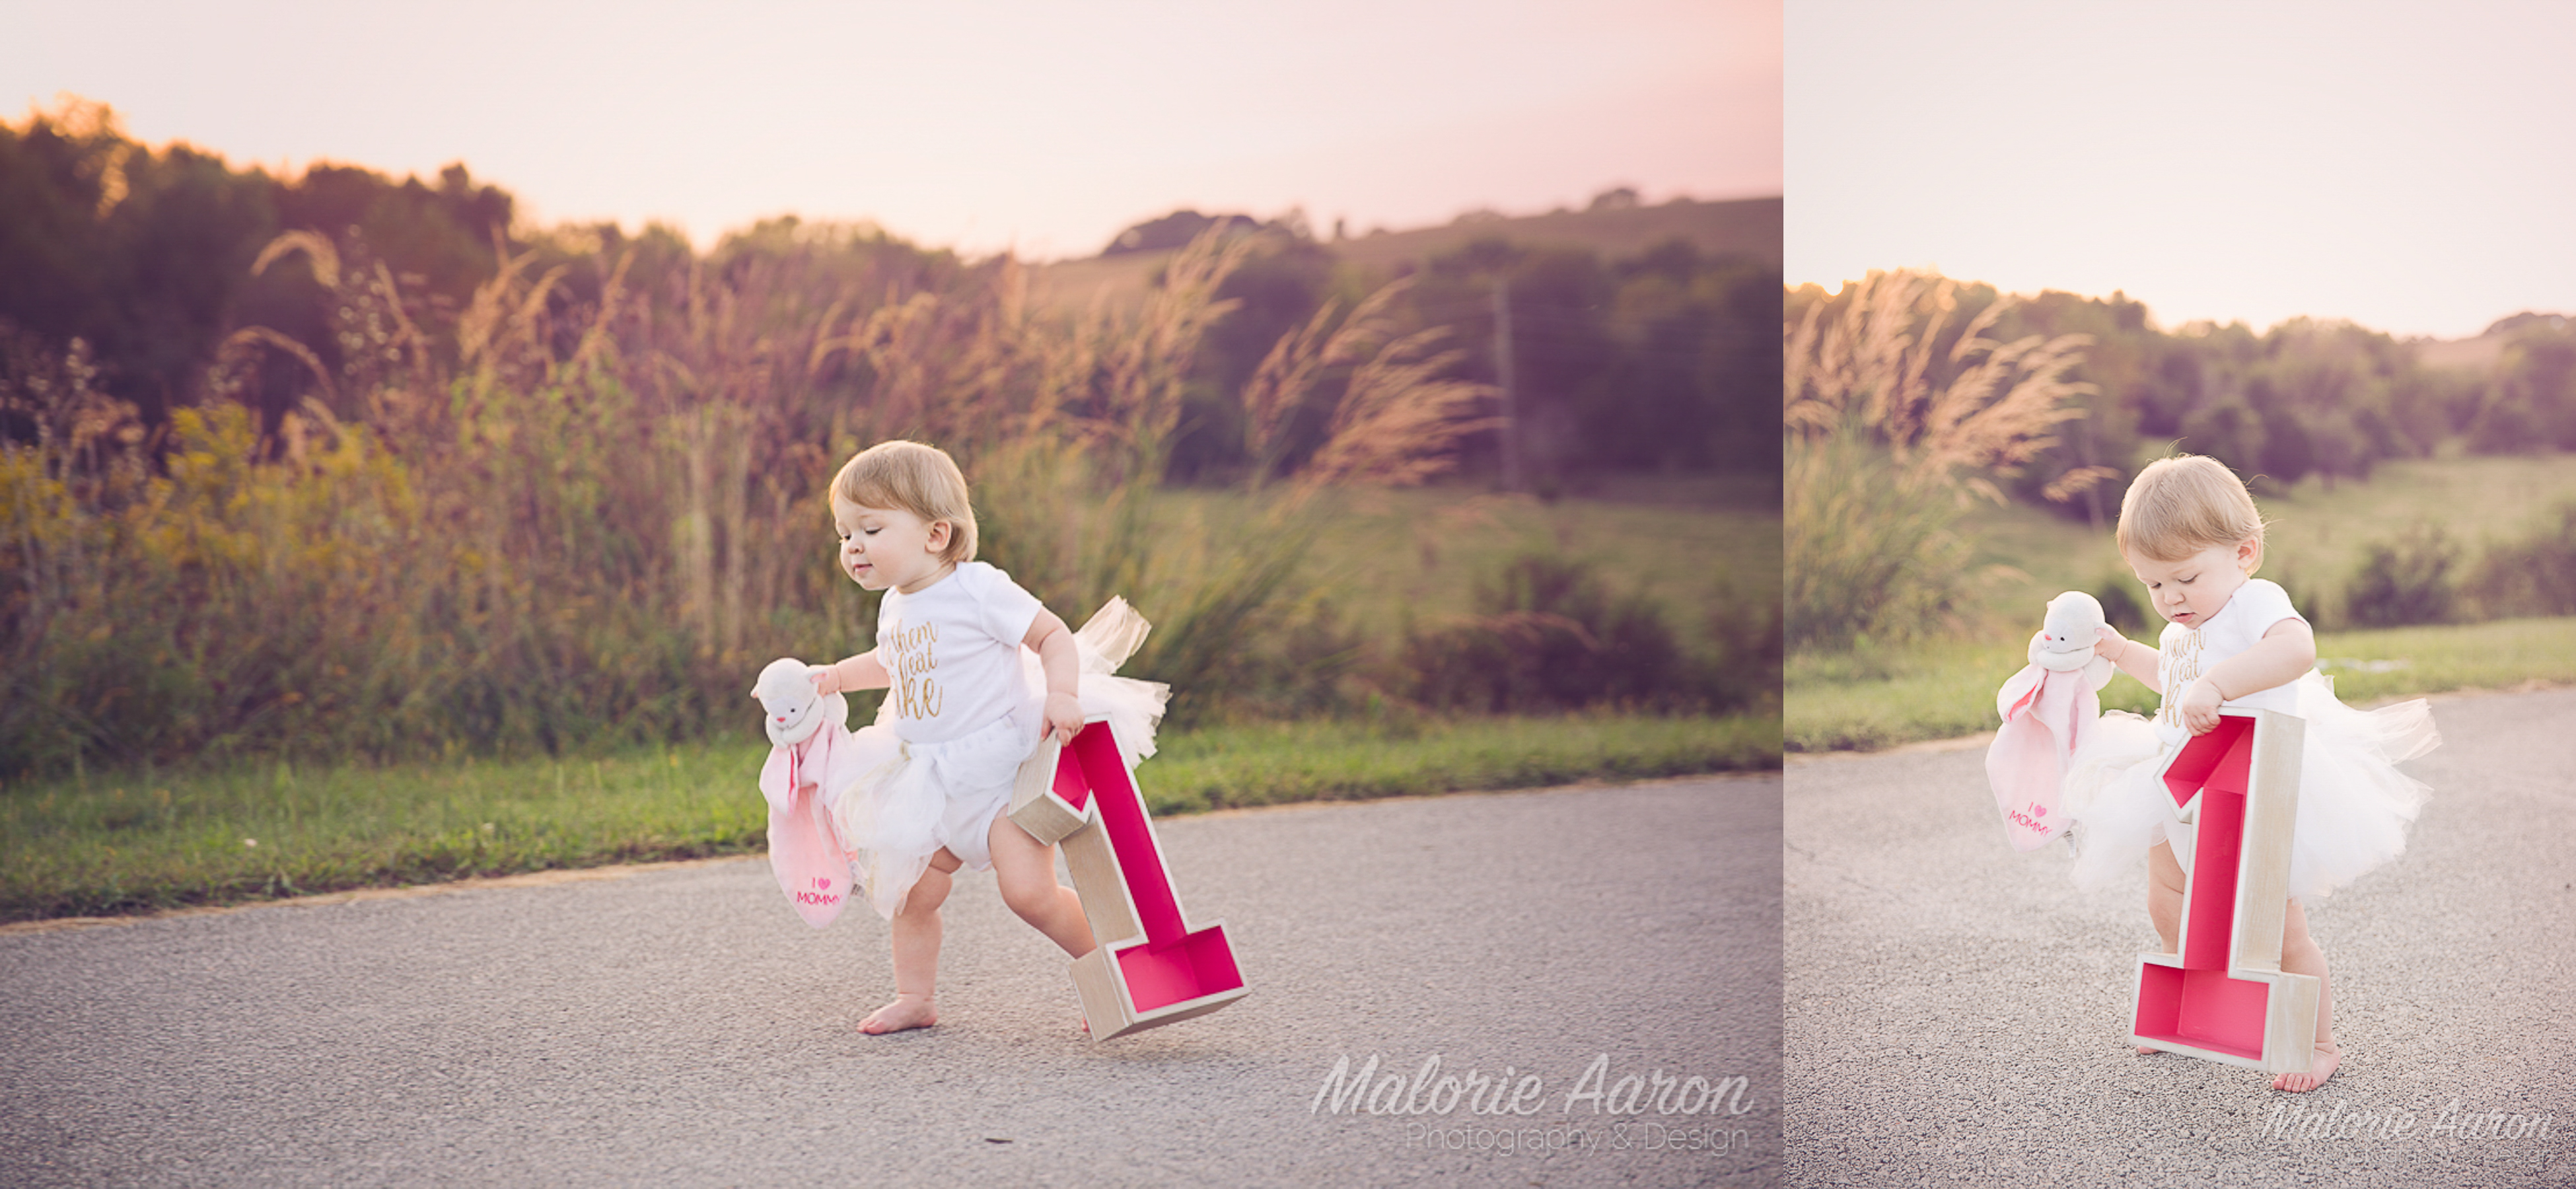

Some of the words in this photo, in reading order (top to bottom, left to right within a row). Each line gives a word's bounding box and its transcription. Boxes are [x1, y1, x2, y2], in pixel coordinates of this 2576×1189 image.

[909, 641, 938, 676] eat
[2028, 801, 2034, 812] I
[2009, 810, 2053, 837] MOMMY
[811, 877, 816, 889] I
[797, 891, 843, 906] MOMMY
